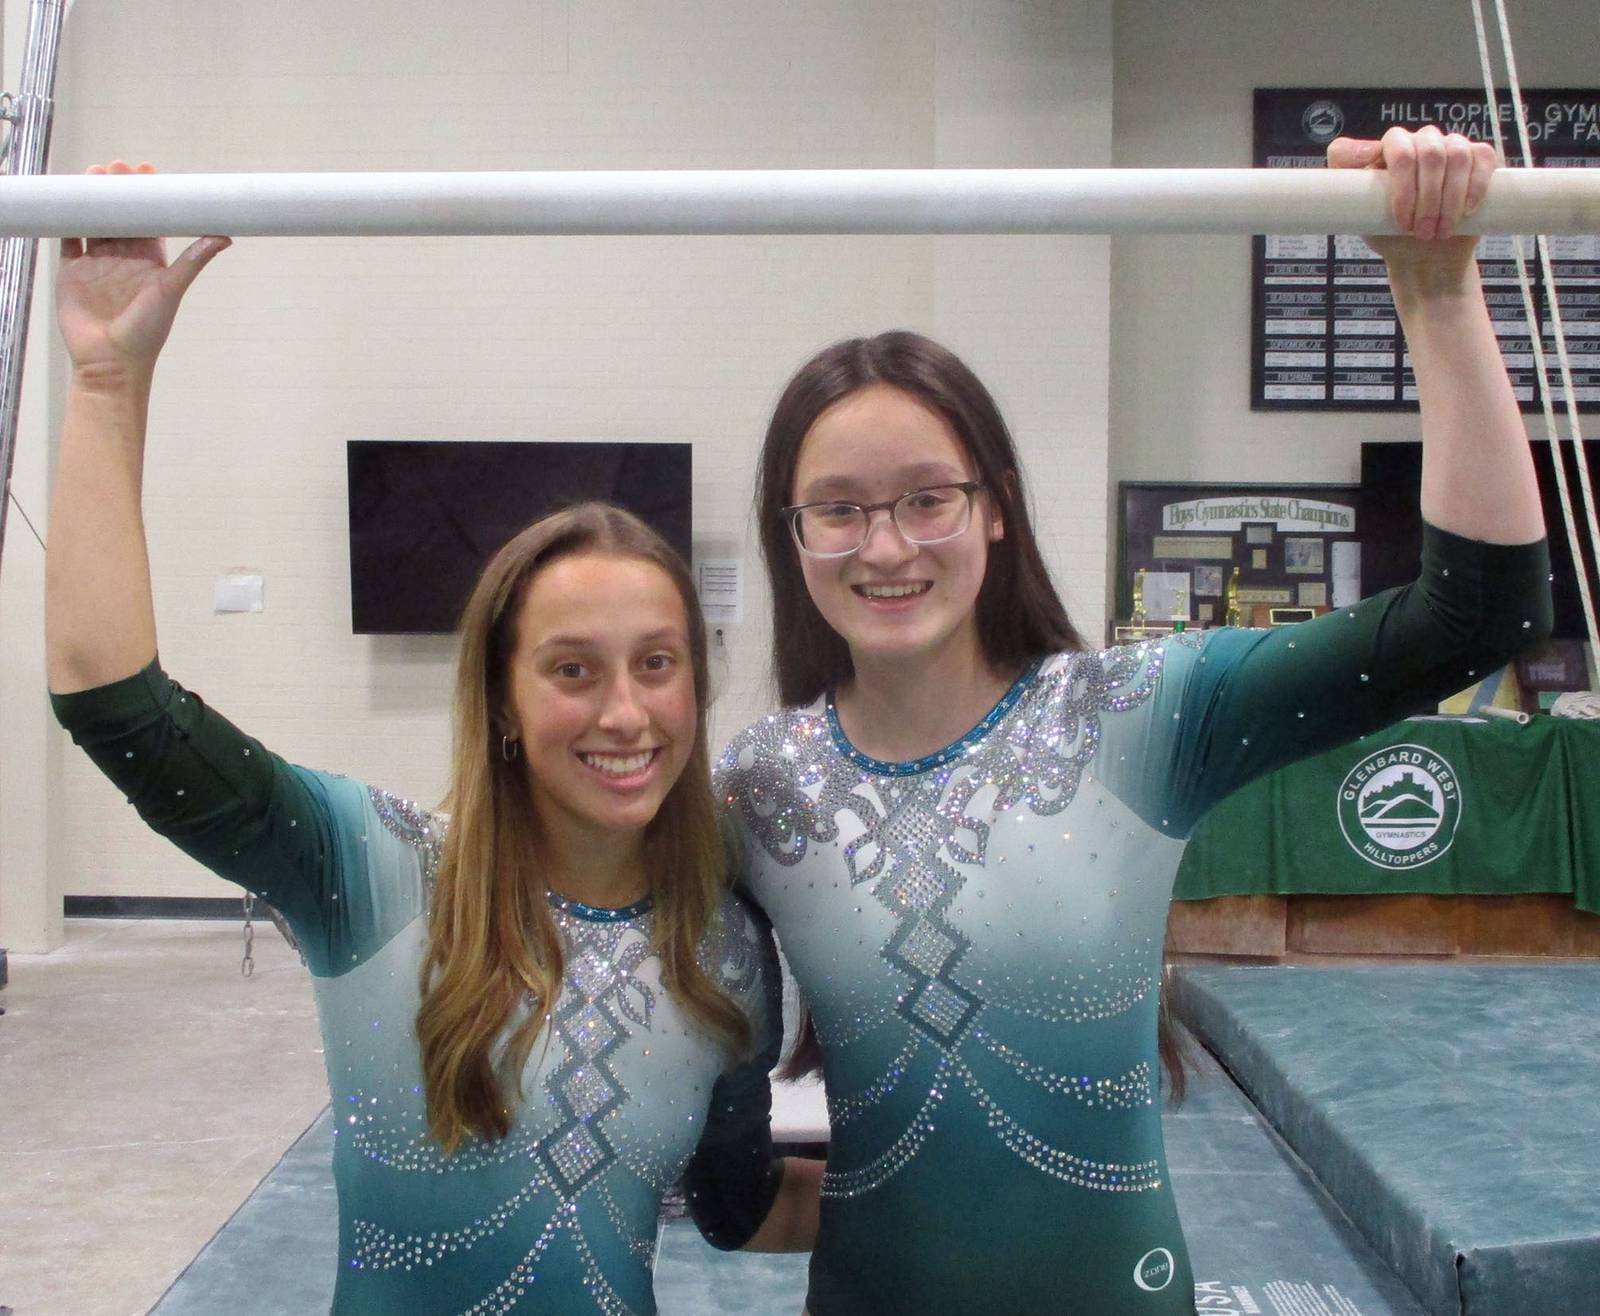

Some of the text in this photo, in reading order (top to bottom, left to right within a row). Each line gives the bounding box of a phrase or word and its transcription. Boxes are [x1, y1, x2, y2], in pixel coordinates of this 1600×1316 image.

[1526, 121, 1557, 140] OF
[1169, 504, 1194, 528] Boys
[1260, 498, 1286, 519] State
[1343, 751, 1456, 801] GLENBARD WEST
[1375, 831, 1426, 839] GYMNASTICS
[1363, 841, 1439, 864] HILLTOPPERS
